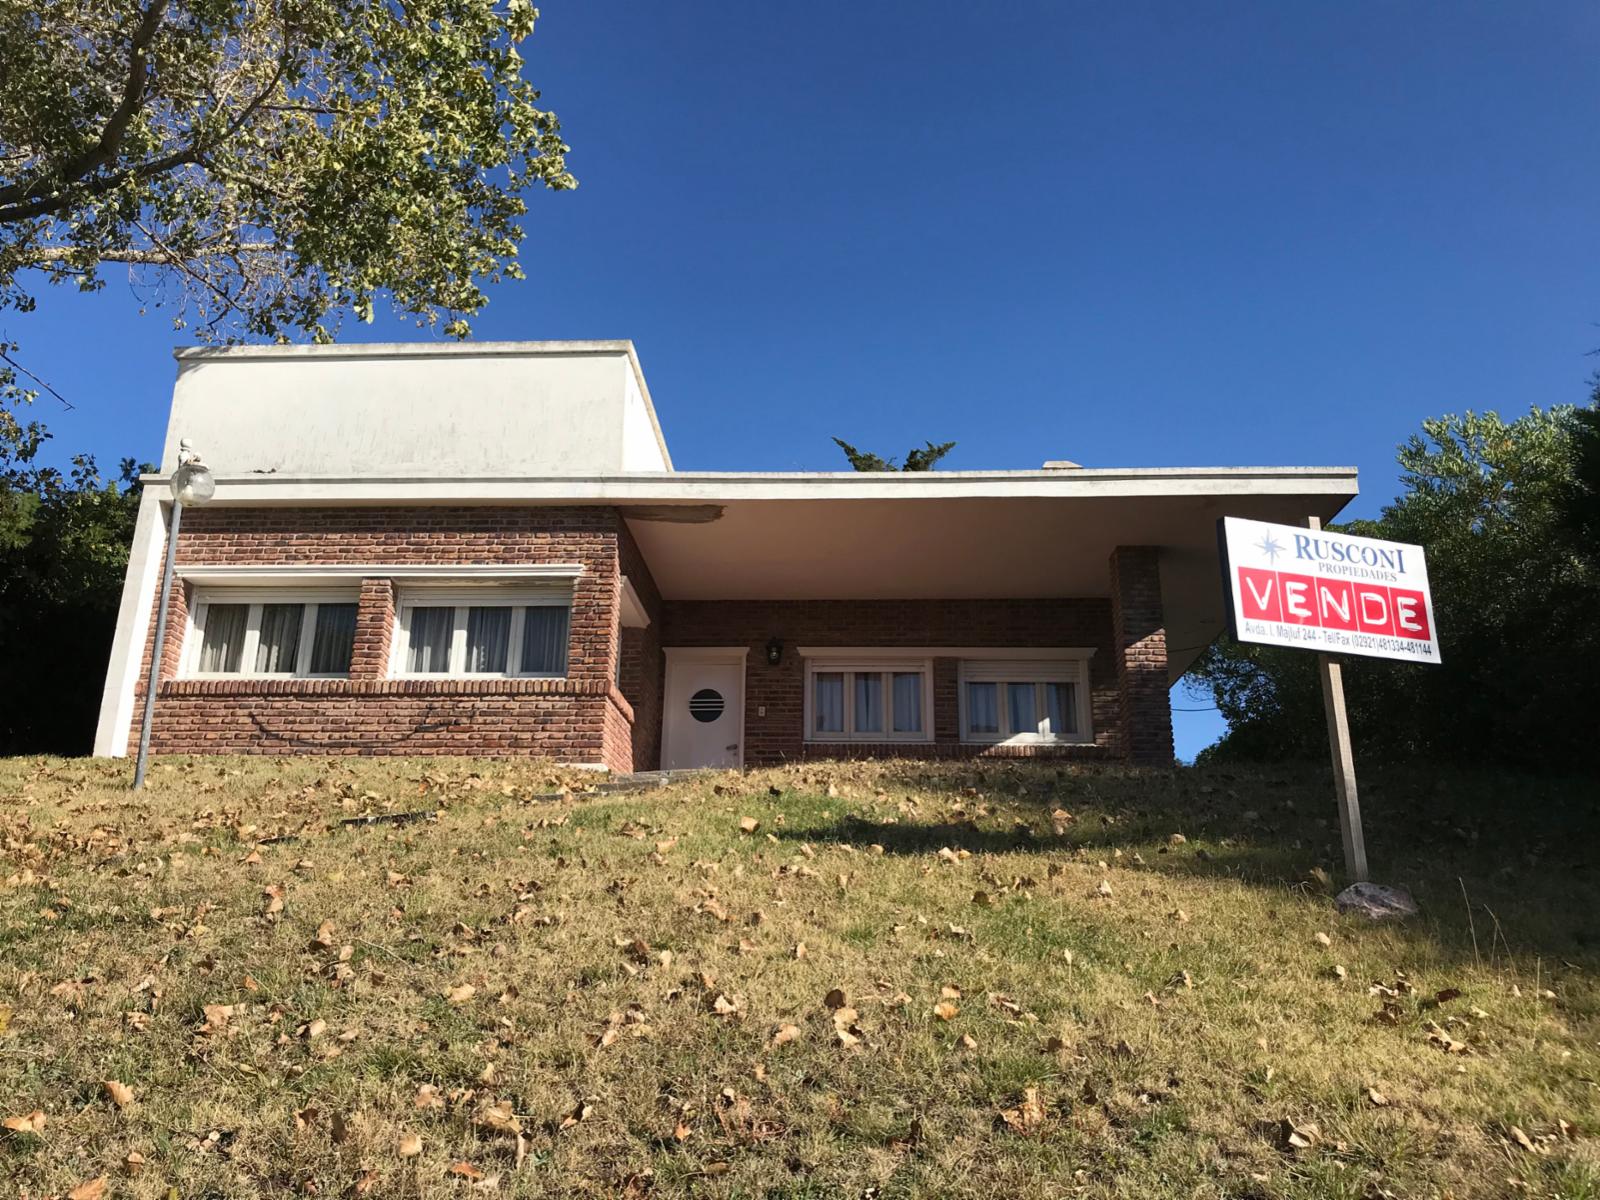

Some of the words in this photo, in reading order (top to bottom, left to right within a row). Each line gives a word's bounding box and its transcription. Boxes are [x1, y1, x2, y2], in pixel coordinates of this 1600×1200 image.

[1293, 534, 1407, 574] RUSCONI
[1318, 562, 1398, 583] PROPIEDADES
[1246, 576, 1423, 632] VENDE
[1245, 621, 1268, 636] Avda.
[1302, 627, 1317, 641] 244
